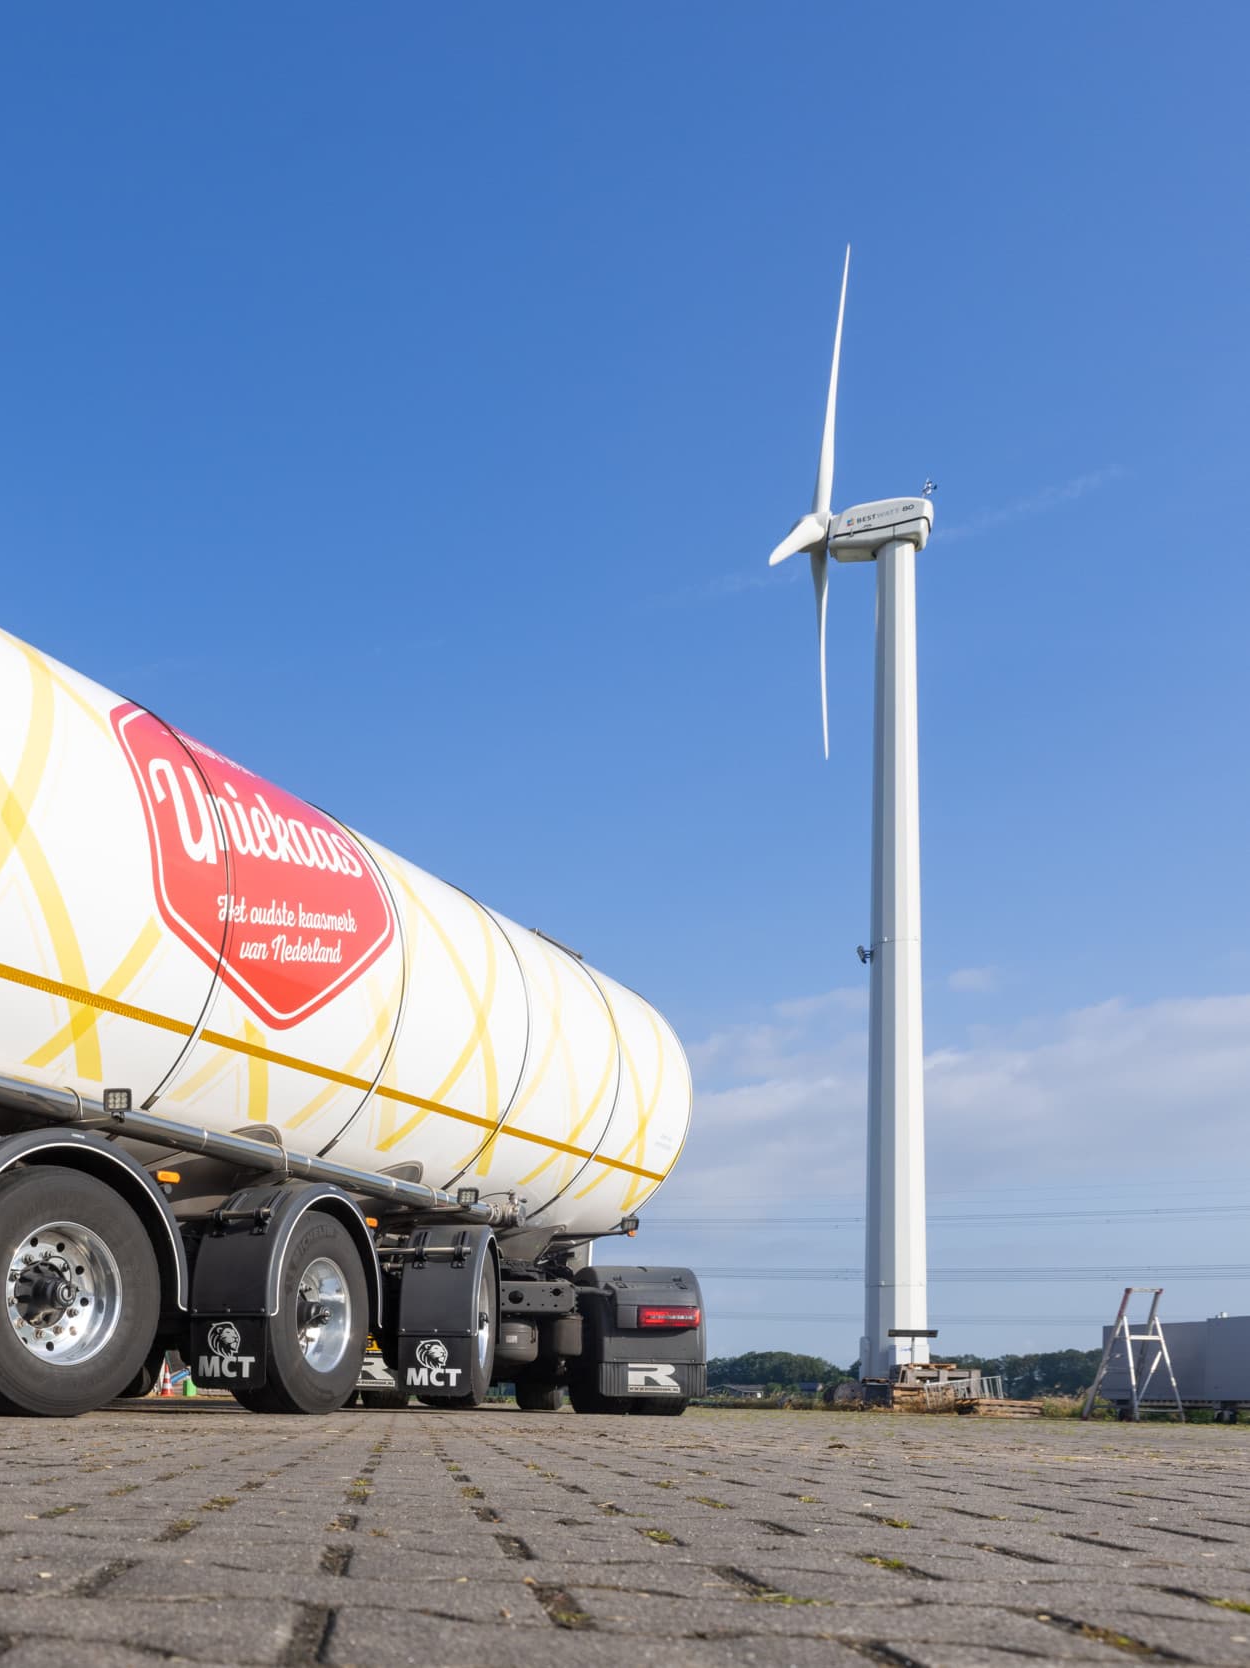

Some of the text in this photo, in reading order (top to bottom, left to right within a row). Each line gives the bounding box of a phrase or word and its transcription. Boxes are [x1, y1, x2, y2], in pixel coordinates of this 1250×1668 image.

[148, 758, 363, 878] Uniekaas
[217, 893, 358, 933] Het oudste kaasmerk
[239, 934, 343, 964] van Nederland
[199, 1356, 255, 1378] MCT
[406, 1368, 462, 1386] MCT
